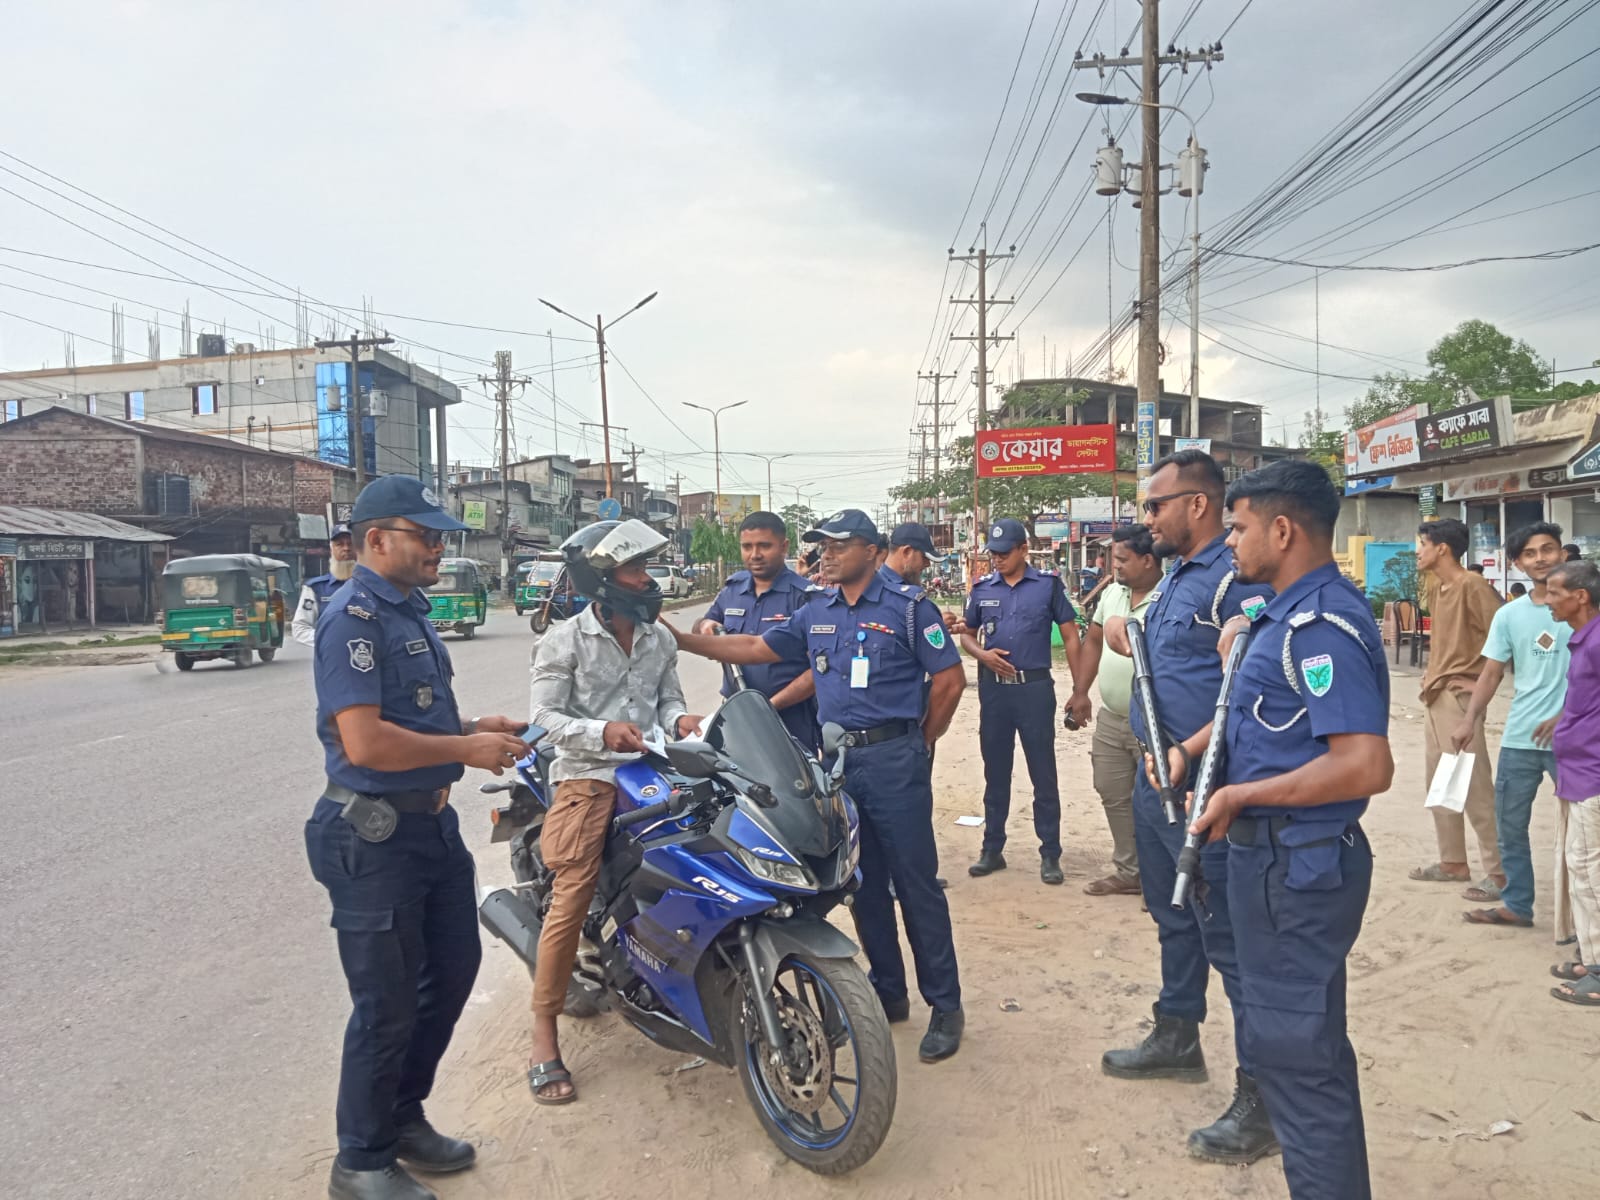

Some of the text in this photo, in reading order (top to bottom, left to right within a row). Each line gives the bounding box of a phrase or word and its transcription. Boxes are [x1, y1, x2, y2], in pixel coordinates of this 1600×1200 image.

[1437, 407, 1490, 434] ক্যাফে সারা
[1001, 437, 1063, 462] কেয়ার
[1440, 435, 1460, 449] CAFE
[1461, 428, 1490, 445] SARAA
[467, 511, 484, 519] ATM
[751, 846, 786, 858] R15
[692, 876, 744, 904] R15
